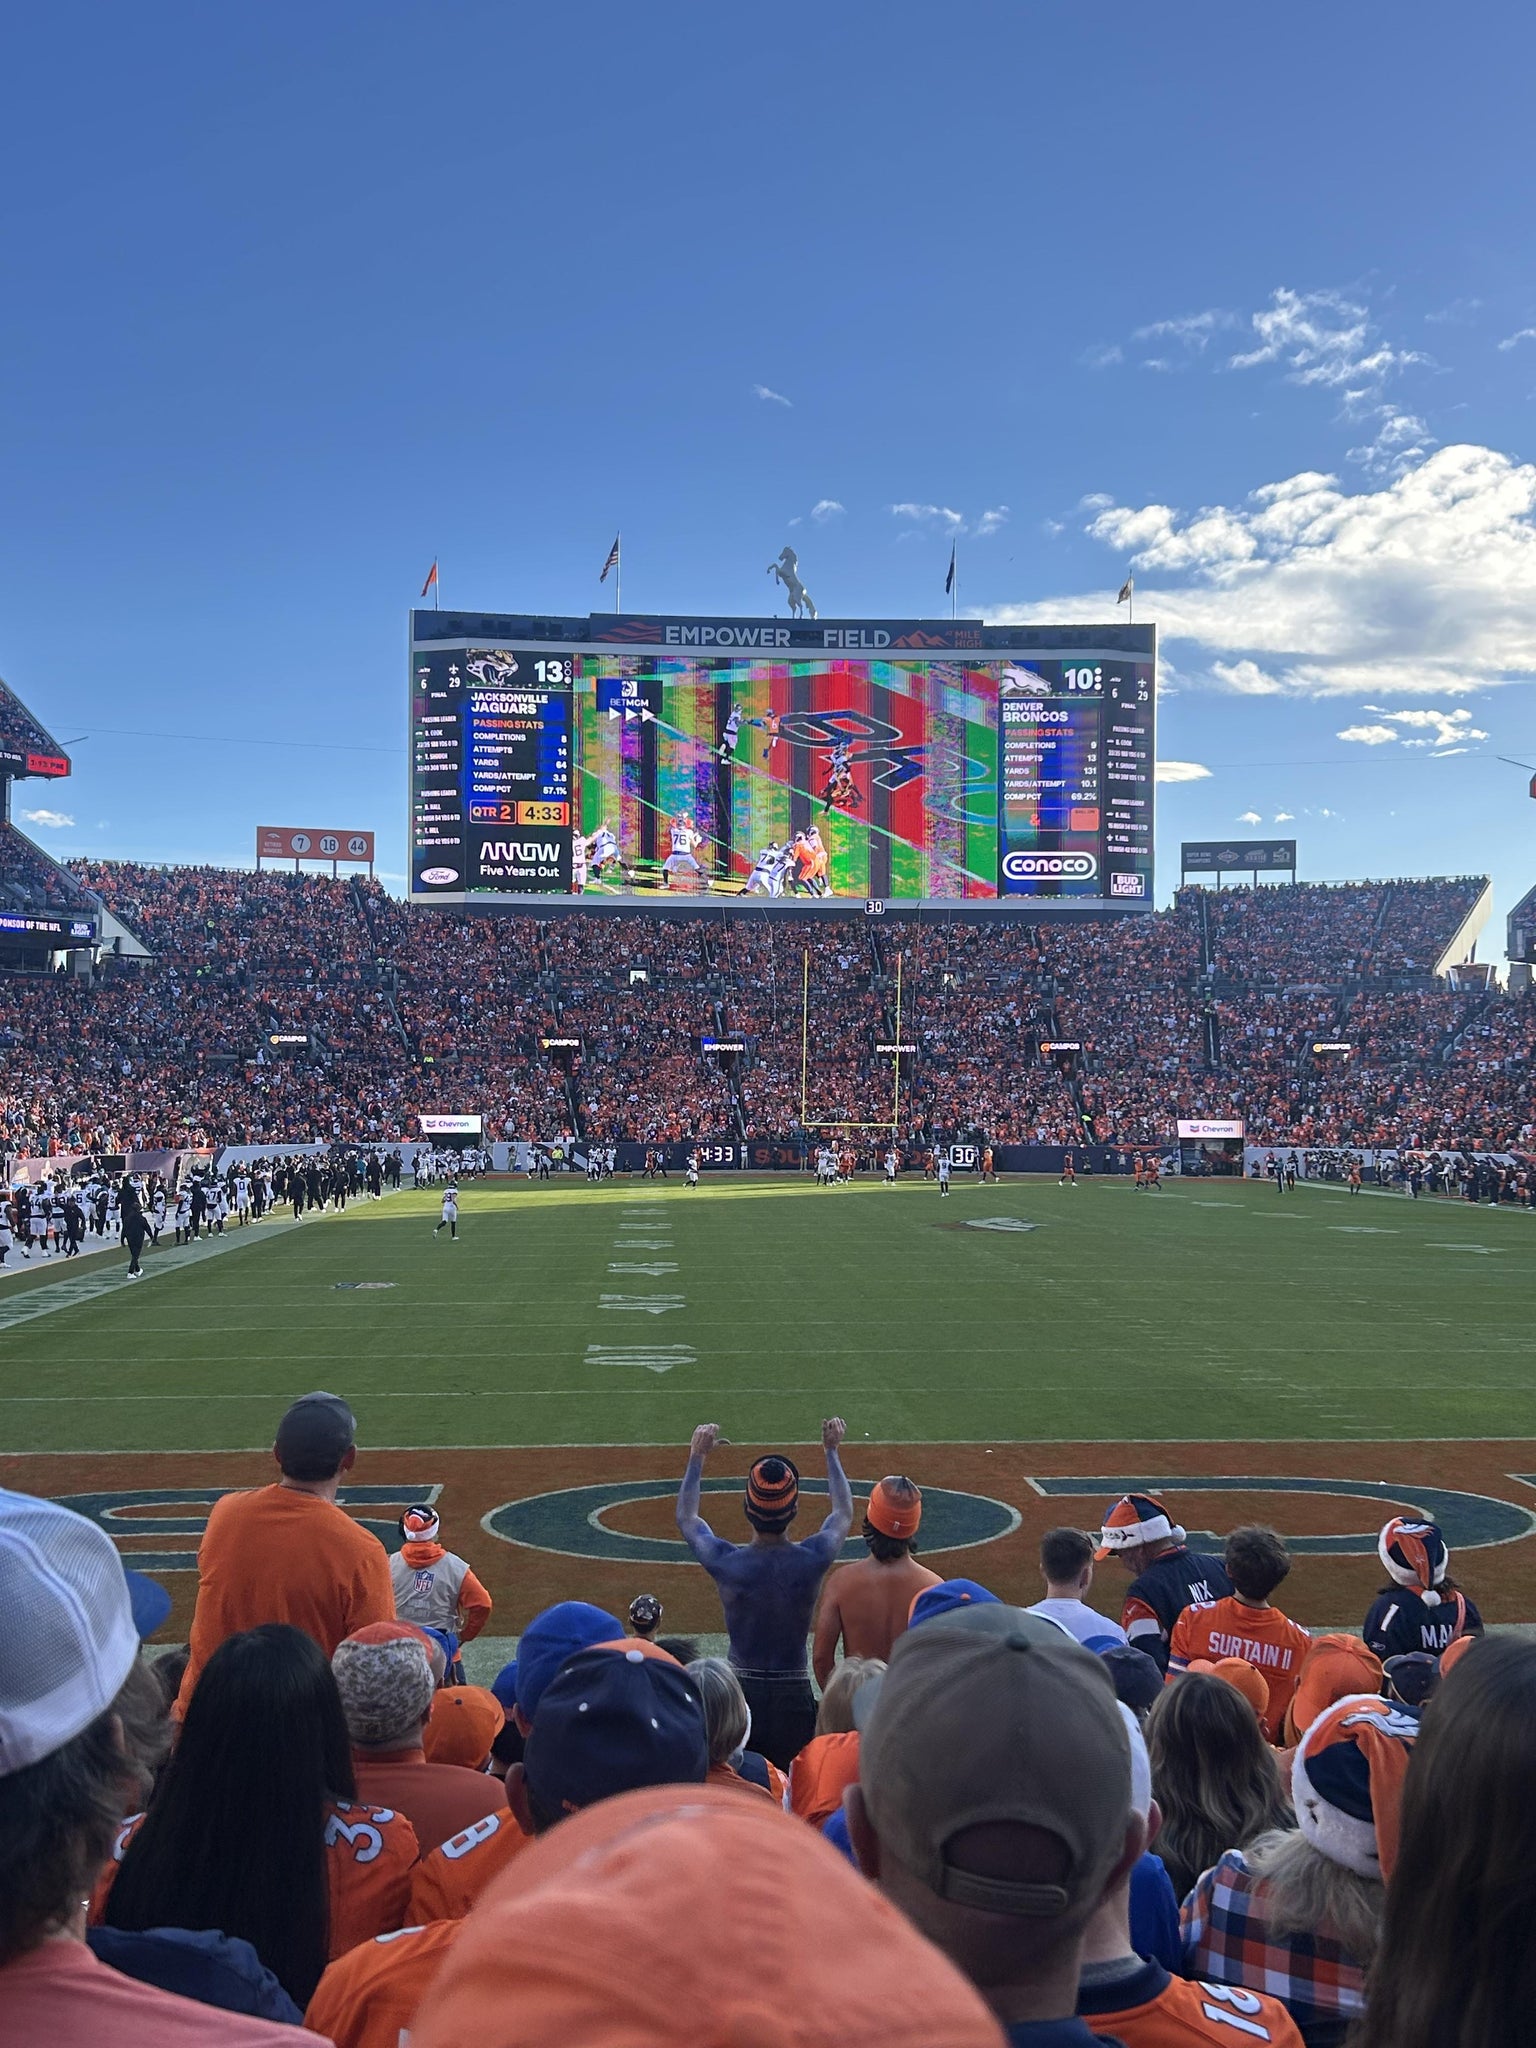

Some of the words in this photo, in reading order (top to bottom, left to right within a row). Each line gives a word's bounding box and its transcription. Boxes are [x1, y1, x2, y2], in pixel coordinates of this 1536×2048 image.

[666, 625, 791, 647] EMPOWER
[823, 629, 891, 648] FIELD
[955, 630, 981, 639] MILE
[955, 639, 982, 648] HIGH
[534, 660, 564, 683] 13
[421, 679, 427, 689] 6
[449, 677, 460, 688] 29
[1064, 668, 1094, 690] 10
[471, 692, 548, 704] JACKSONVILLE
[1112, 688, 1118, 699] 6
[1138, 690, 1149, 701] 29
[471, 701, 537, 715] JAGUARS
[1003, 702, 1044, 711] DENVER
[1002, 711, 1069, 722] BRONCOS
[473, 719, 514, 729] PASSING
[514, 721, 544, 729] STATS
[473, 732, 527, 742] COMPLETIONS
[1004, 729, 1044, 737] PASSING
[1044, 729, 1074, 737] STATS
[473, 745, 513, 754] ATTEMPTS
[557, 748, 567, 756] 14
[1004, 741, 1057, 750] COMPLETIONS
[473, 758, 499, 766] YARDS
[556, 761, 567, 769] 64
[1004, 754, 1043, 762] ATTEMPTS
[1087, 754, 1097, 762] 13
[473, 771, 536, 780] YARDS/ATTEMPT
[552, 774, 567, 782] 3.8
[1004, 767, 1030, 775] YARDS
[1083, 767, 1097, 775] 131
[1004, 780, 1066, 788] YARDS/ATTEMPT
[1081, 780, 1097, 788] 10.1
[496, 785, 511, 793] PCT
[543, 786, 567, 795] 57.1%
[1071, 793, 1097, 801] 69.2%
[472, 806, 497, 817] QTR
[500, 805, 511, 820] 2
[525, 806, 562, 820] 4:33
[1030, 813, 1040, 826] &
[298, 837, 304, 849] 7
[323, 838, 336, 851] 18
[673, 833, 686, 846] 76
[350, 840, 364, 852] 44
[480, 842, 560, 861] ARROW
[428, 871, 450, 881] Ford
[480, 865, 504, 876] Five
[504, 865, 536, 877] Years
[538, 866, 560, 877] Out
[1117, 875, 1138, 885] BUD
[1113, 884, 1142, 894] LIGHT
[868, 901, 882, 912] 30
[26, 920, 35, 930] OF
[35, 921, 48, 931] THE
[49, 923, 61, 932] NFL
[703, 1043, 744, 1051] EMPOWER
[438, 1120, 469, 1128] Chevron
[1202, 1125, 1234, 1133] Chevron
[701, 1146, 733, 1162] 4:33
[239, 1181, 246, 1191] 0
[415, 1580, 432, 1592] NFL
[1188, 1580, 1214, 1604] NIX
[1380, 1603, 1400, 1632] 1
[1208, 1631, 1280, 1668] SURTAIN
